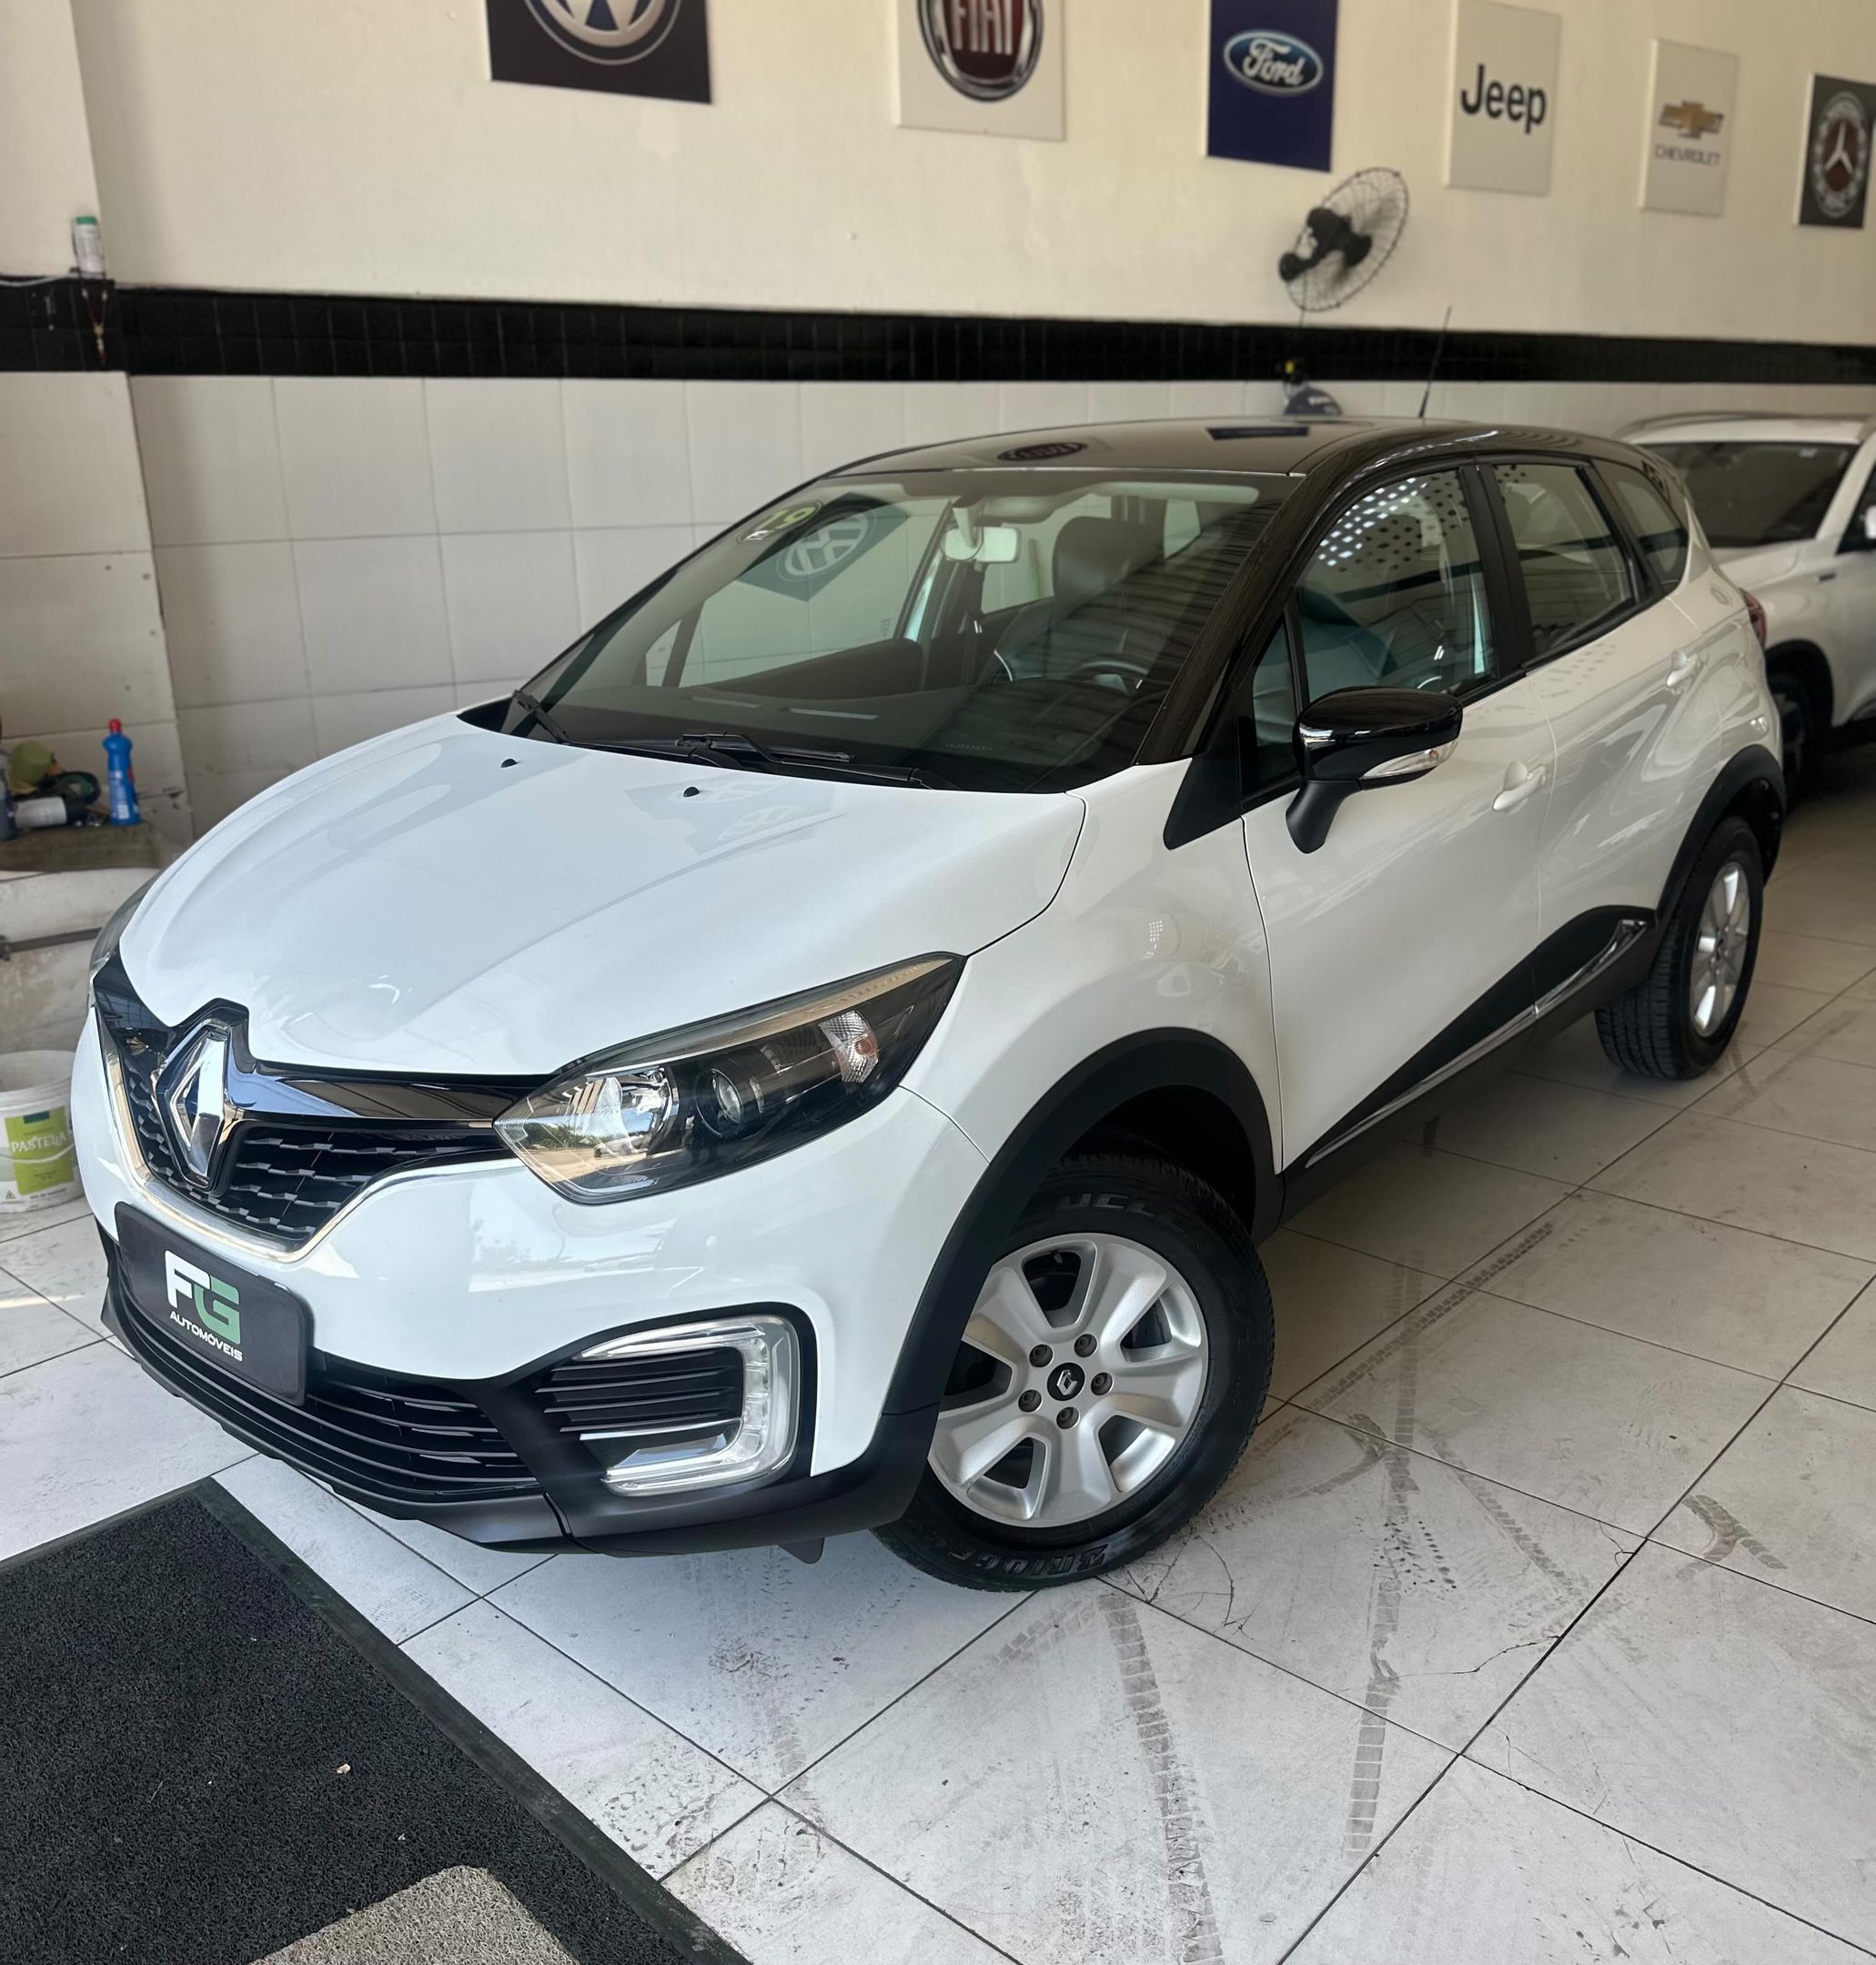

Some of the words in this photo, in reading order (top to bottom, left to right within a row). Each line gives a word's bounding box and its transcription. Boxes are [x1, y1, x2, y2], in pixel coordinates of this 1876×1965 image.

[1242, 38, 1306, 86] Ford
[1460, 63, 1547, 135] Jeep
[165, 1250, 241, 1345] FG
[169, 1310, 243, 1362] AUTOMÓVEIS
